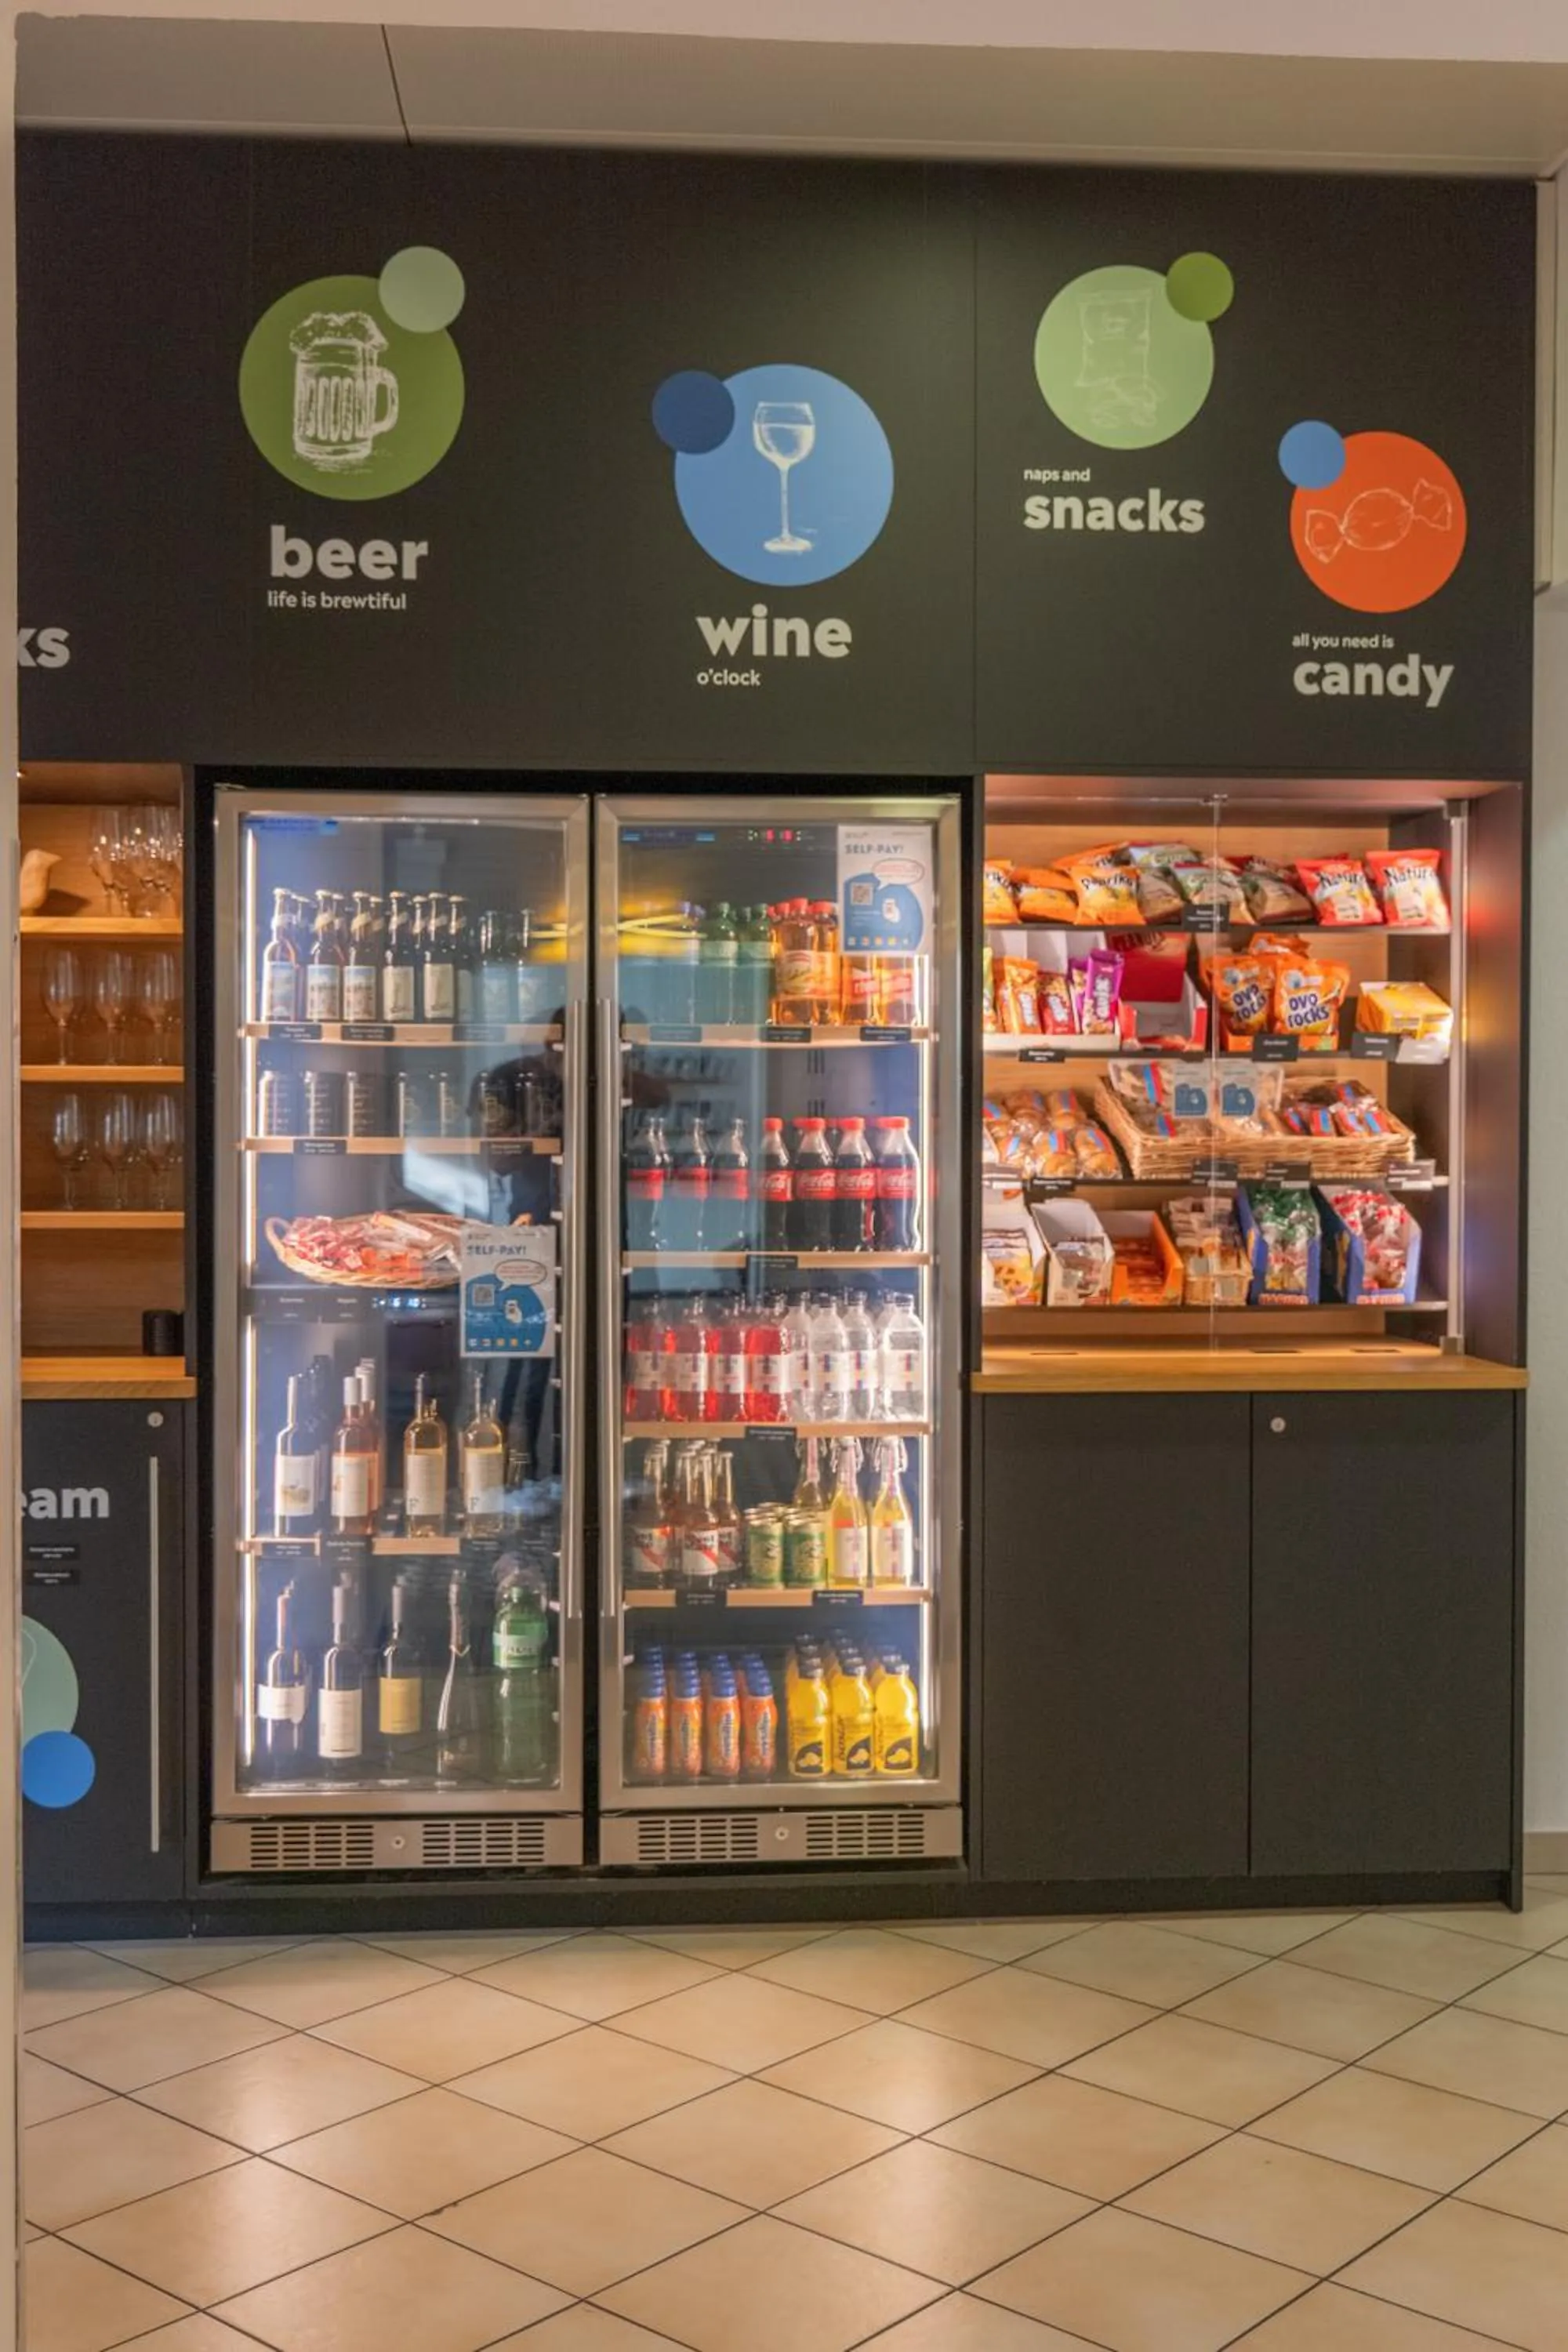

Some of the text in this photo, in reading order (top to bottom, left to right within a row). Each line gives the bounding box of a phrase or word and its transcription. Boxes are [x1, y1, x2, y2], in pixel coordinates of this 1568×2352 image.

[1023, 467, 1091, 485] naps and
[1023, 488, 1205, 533] snacks
[270, 524, 429, 580] beer
[267, 590, 406, 610] life is brewtiful
[695, 603, 852, 659] wine
[1292, 633, 1395, 651] all you need is
[696, 668, 761, 687] o'clock
[1293, 653, 1454, 708] candy
[21, 1486, 110, 1519] am
